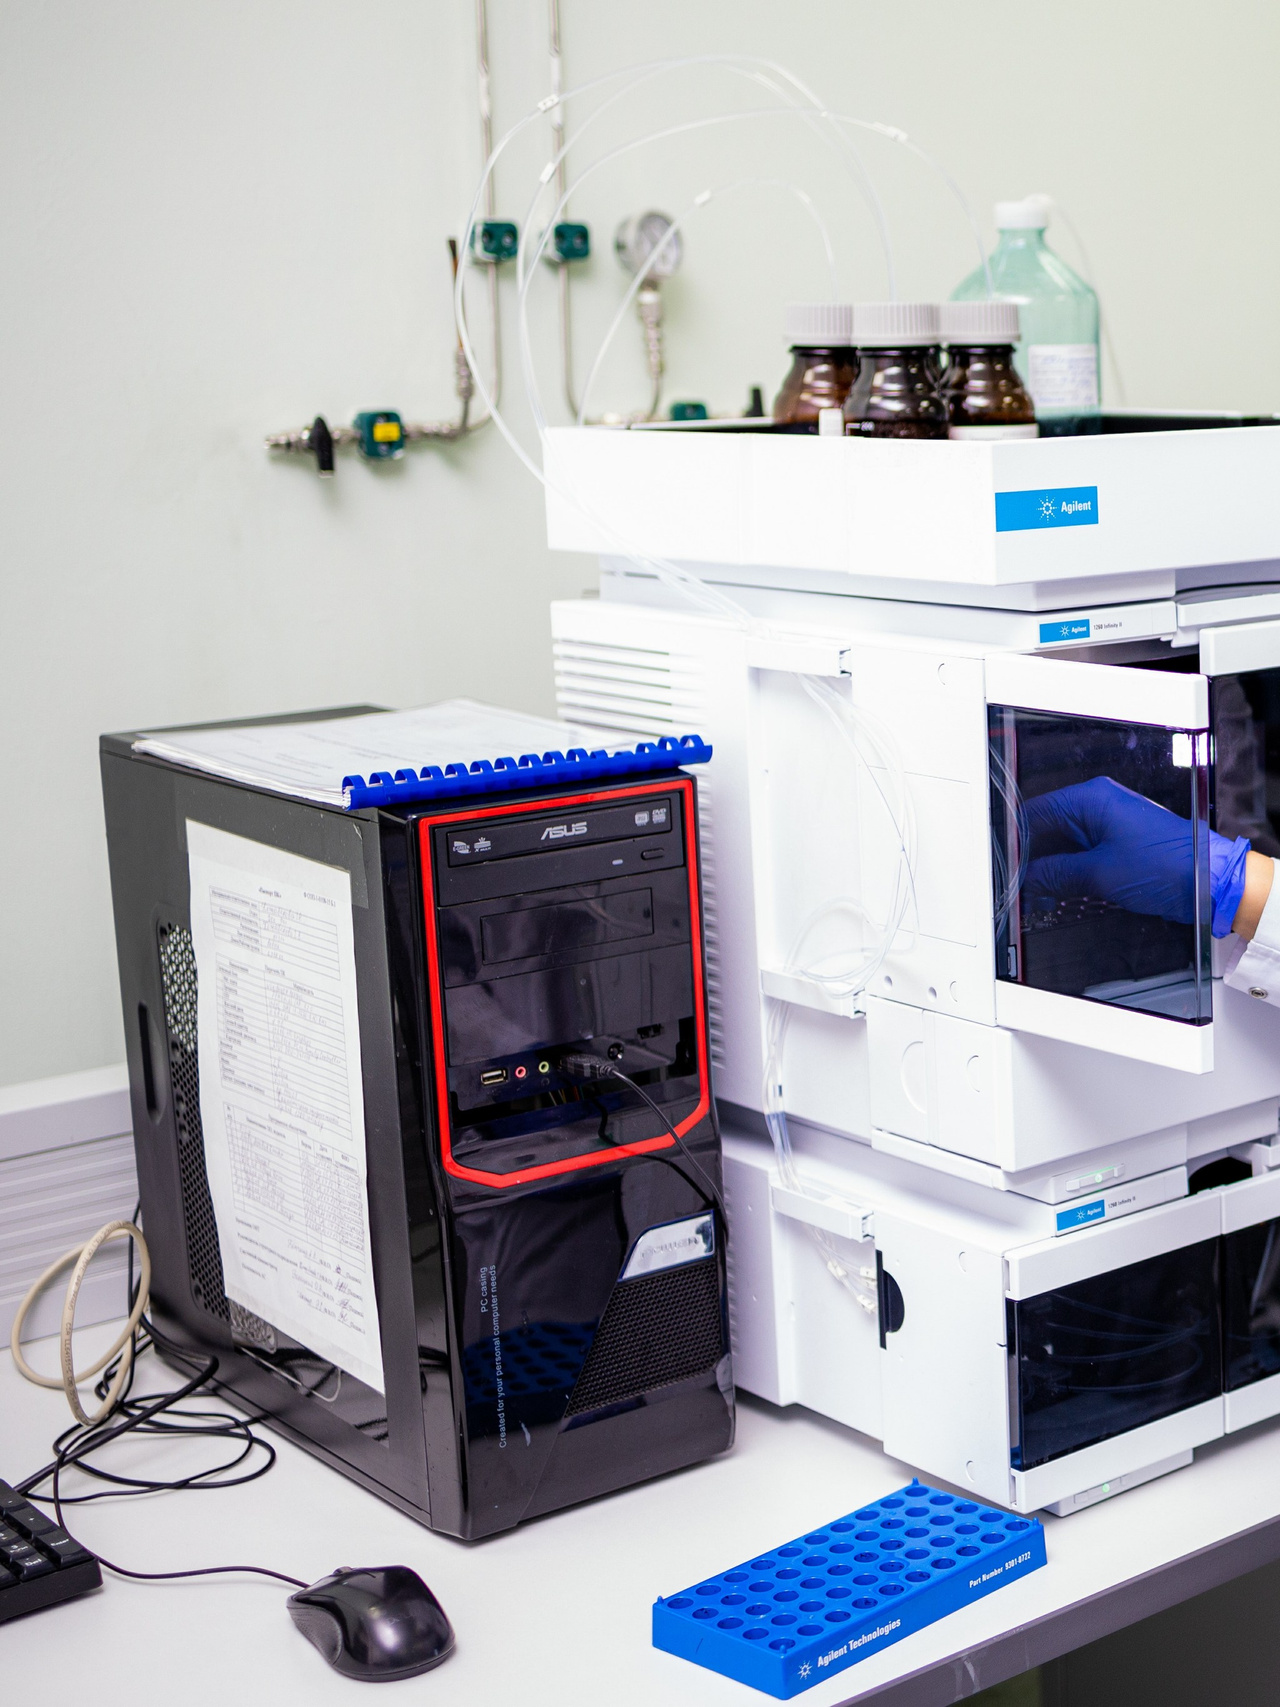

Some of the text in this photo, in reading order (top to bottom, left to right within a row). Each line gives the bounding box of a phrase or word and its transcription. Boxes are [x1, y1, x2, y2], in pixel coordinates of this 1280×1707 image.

[1060, 500, 1092, 515] Agilent
[1071, 626, 1087, 634] Agilent
[541, 821, 587, 841] ASUS
[1086, 1207, 1102, 1216] Agilent
[1118, 1198, 1132, 1206] Infinity
[480, 1266, 488, 1313] PC casing
[489, 1264, 507, 1448] Created for your personal computer needs
[969, 1551, 1031, 1589] Part Number 9301-0722
[817, 1618, 901, 1667] Agilent Technologies
